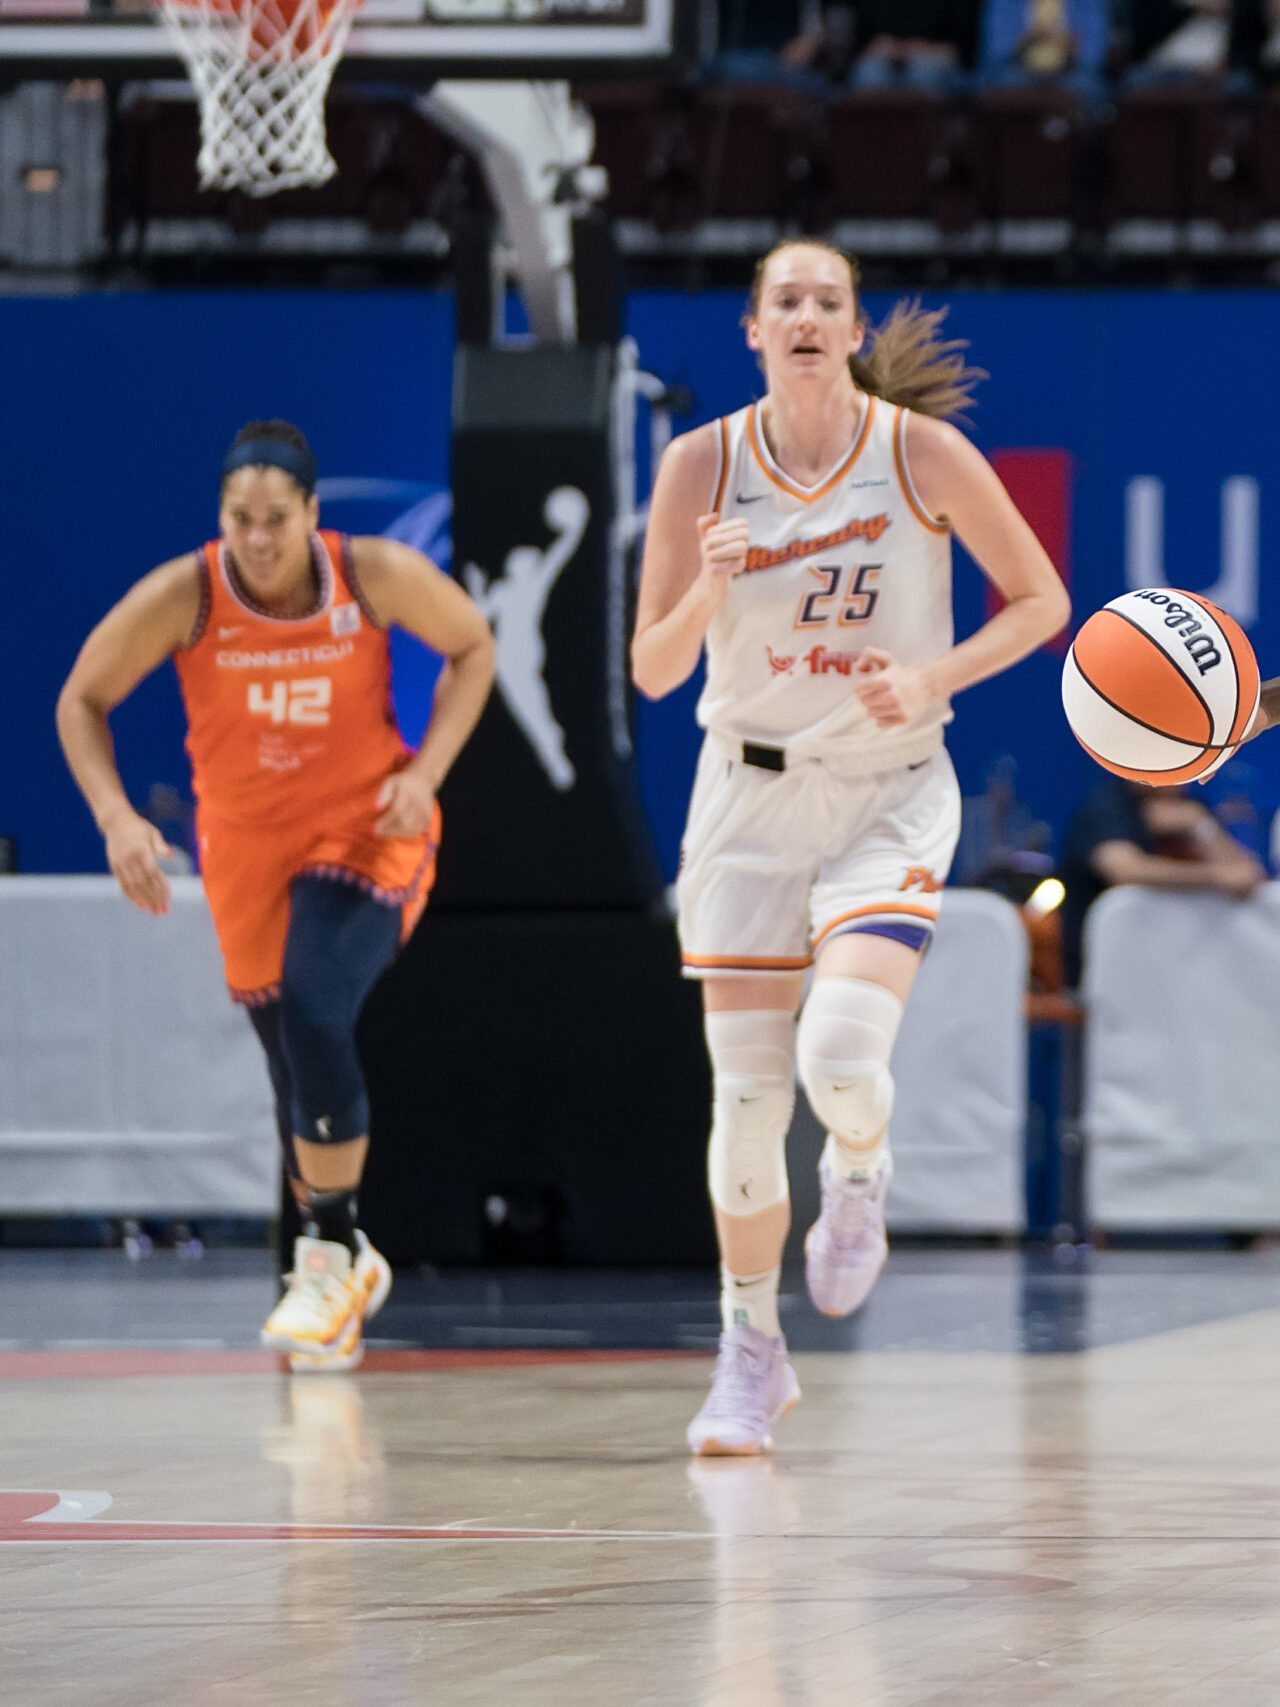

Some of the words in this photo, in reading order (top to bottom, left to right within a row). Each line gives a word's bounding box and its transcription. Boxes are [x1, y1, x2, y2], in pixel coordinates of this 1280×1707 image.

[793, 562, 884, 631] 25
[1133, 590, 1222, 677] Wilson
[247, 676, 332, 726] 42
